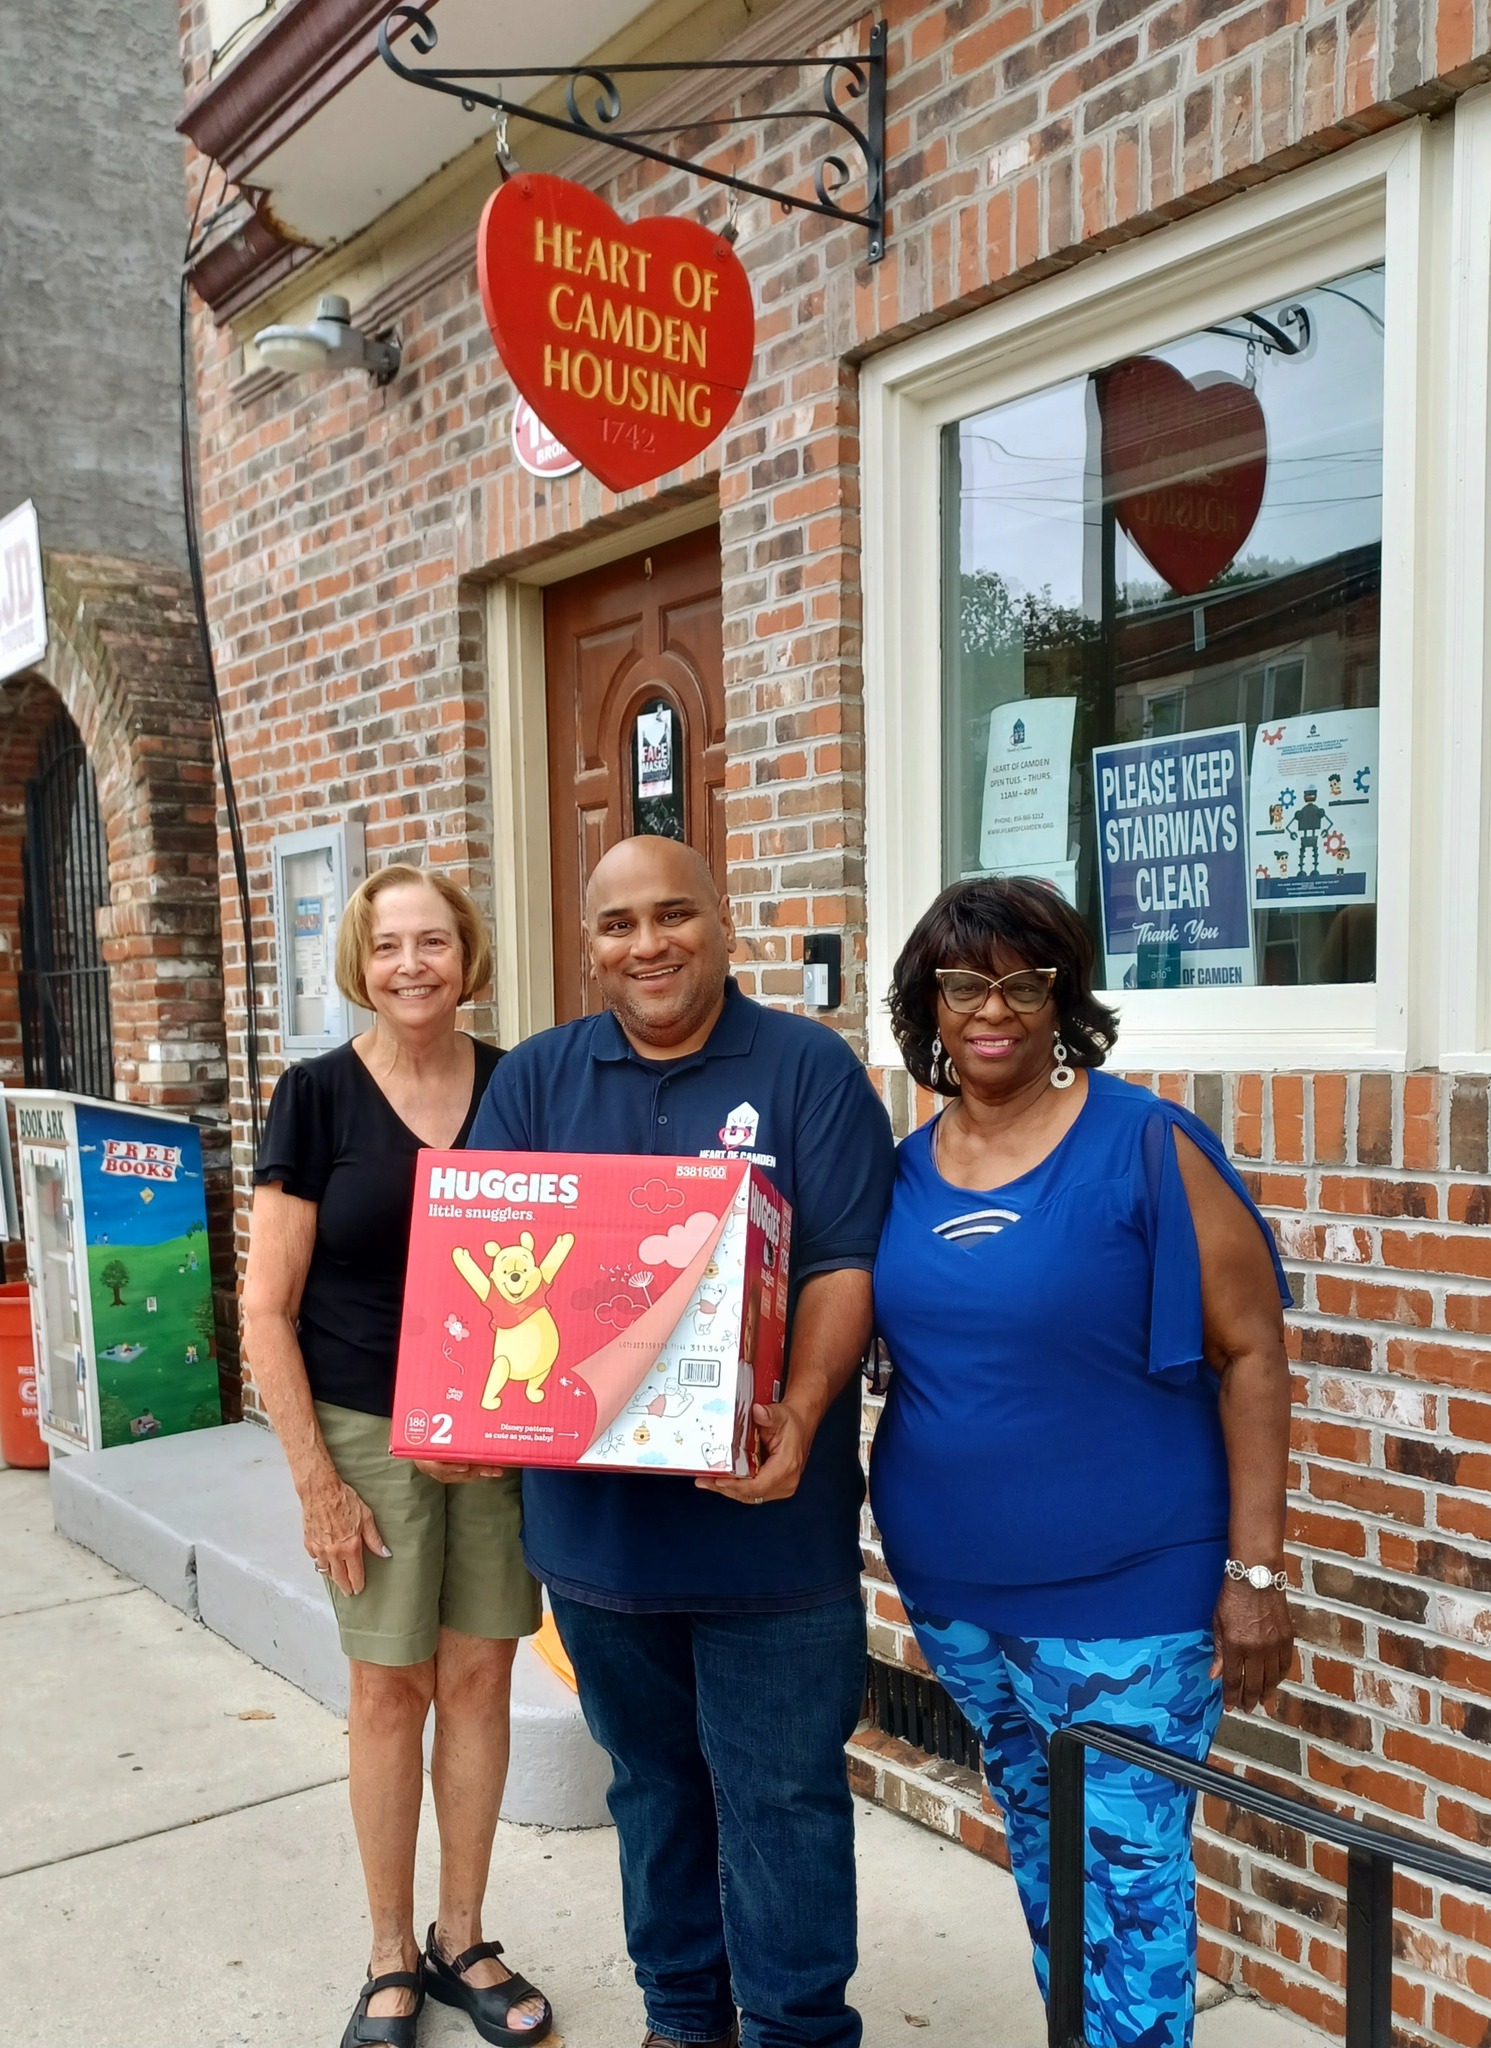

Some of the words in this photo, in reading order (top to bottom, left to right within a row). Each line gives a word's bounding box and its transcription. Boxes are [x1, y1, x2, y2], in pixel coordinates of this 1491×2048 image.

[534, 217, 652, 292] HEART
[672, 261, 719, 312] OF
[548, 282, 707, 368] CAMDEN
[543, 344, 711, 427] HOUSING
[599, 416, 656, 453] 1742
[642, 743, 668, 762] FACE
[642, 759, 669, 773] MASKS
[993, 763, 1010, 773] HEART
[1011, 762, 1020, 771] OF
[1020, 758, 1050, 769] CAMDEN
[990, 779, 1004, 788] OPEN
[1005, 776, 1022, 785] TUES.
[1028, 772, 1053, 781] THURS.
[1102, 758, 1176, 812] PLEASE
[1181, 749, 1235, 801] KEEP
[1000, 790, 1018, 800] 11AM
[1105, 804, 1238, 863] STAIRWAYS
[1135, 862, 1210, 912] CLEAR
[1132, 922, 1180, 945] Thank
[1183, 919, 1219, 944] You
[1183, 968, 1195, 985] OF
[1198, 966, 1243, 985] CAMDEN
[19, 1109, 45, 1138] BOOK
[46, 1110, 66, 1140] ARK
[107, 1141, 175, 1162] FREE
[740, 1151, 776, 1168] CAMDEN
[105, 1158, 173, 1178] BOOKS
[429, 1167, 579, 1204] HUGGIES
[428, 1203, 462, 1217] little
[750, 1180, 781, 1246] HUGGIES
[408, 1417, 426, 1427] 186
[429, 1413, 453, 1444] 2
[500, 1423, 524, 1433] Disney
[524, 1425, 554, 1434] patterns
[518, 1434, 533, 1442] you,
[533, 1433, 553, 1443] baby!
